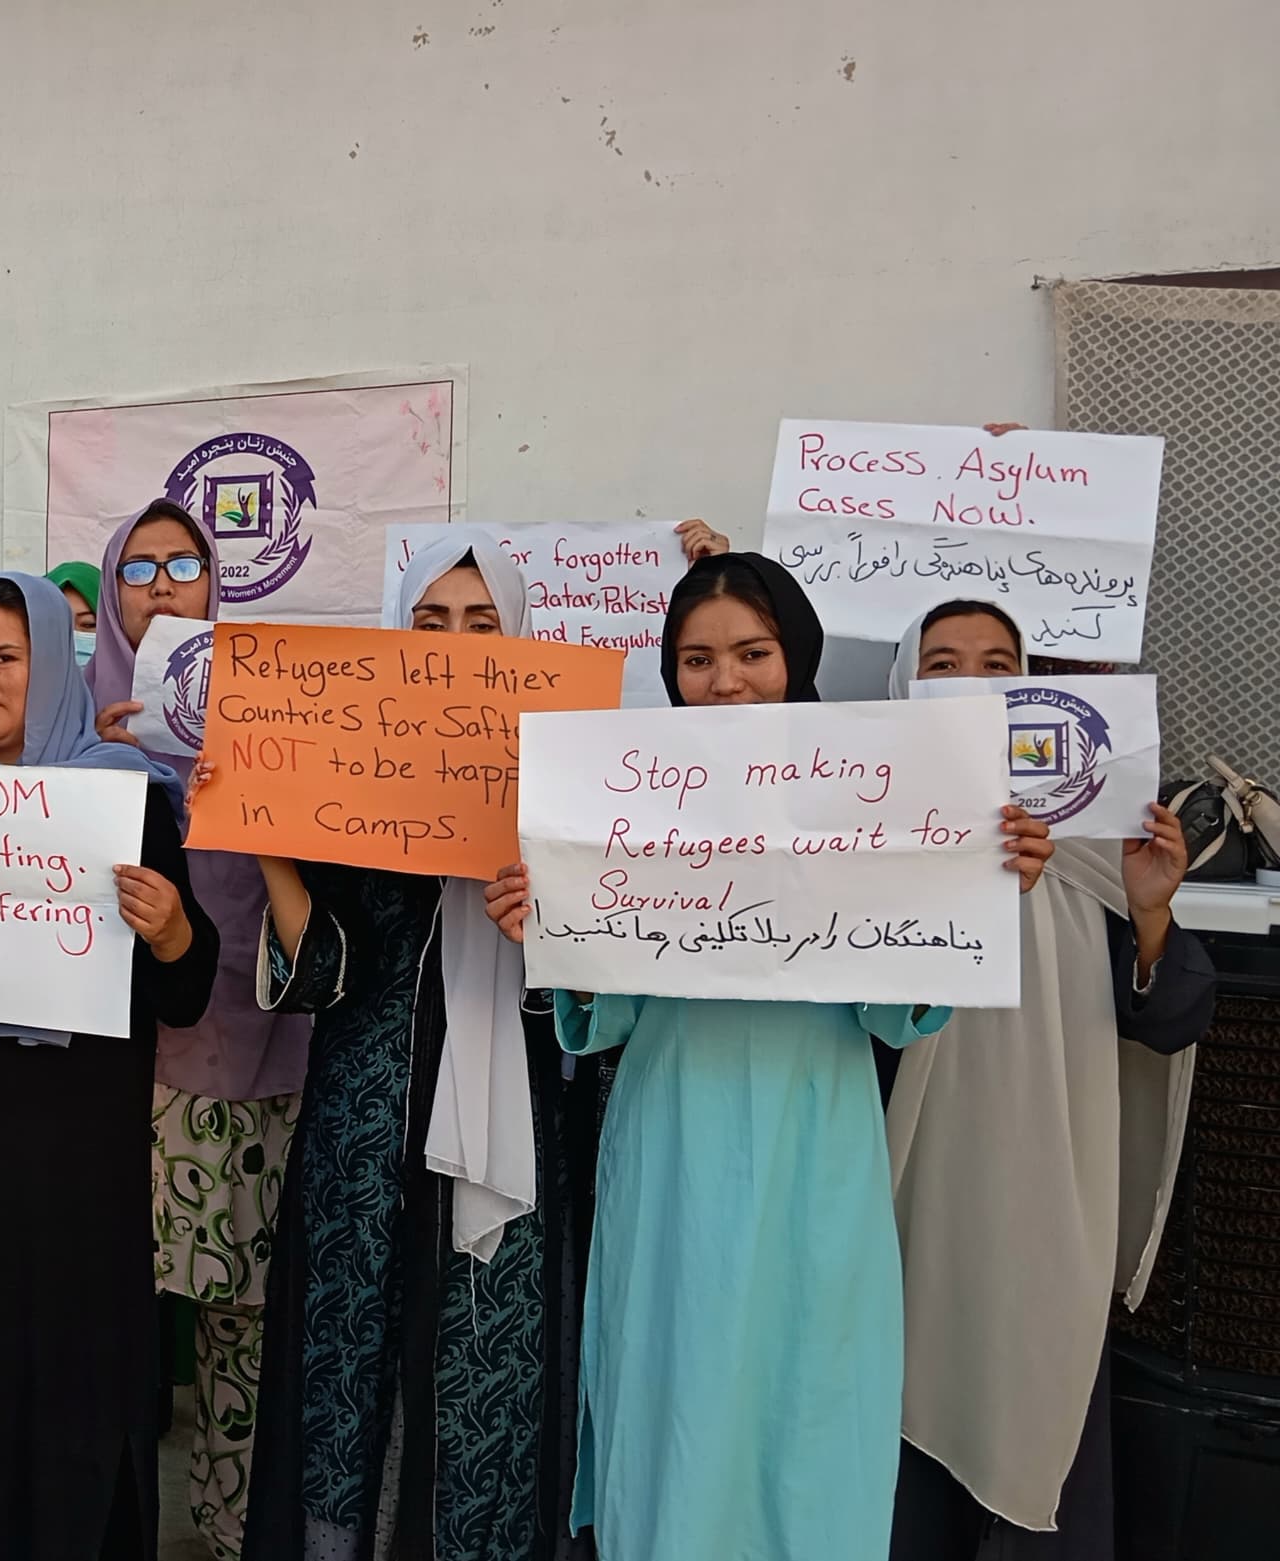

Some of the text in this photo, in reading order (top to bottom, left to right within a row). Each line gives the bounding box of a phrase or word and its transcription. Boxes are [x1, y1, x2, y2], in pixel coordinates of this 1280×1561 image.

[176, 434, 298, 482] جنبش زنان پنجره امید
[956, 446, 1089, 501] Asylum
[798, 487, 897, 520] Cases
[220, 566, 250, 578] 2022
[262, 555, 298, 590] Movement
[498, 538, 660, 583] or forgotten
[600, 585, 669, 615] Pakist
[581, 626, 662, 659] Everywhe
[229, 633, 560, 697] Refugees left thier
[218, 694, 363, 733] Countries
[378, 697, 427, 737] for
[1007, 692, 1029, 706] پنج
[232, 736, 316, 773] NOT
[434, 748, 519, 808] trapp
[604, 747, 893, 810] Stop making
[242, 794, 470, 855] in Camps.
[1019, 798, 1047, 808] 2022
[604, 808, 972, 870] Refugees wait for
[591, 868, 734, 912] Survival
[847, 918, 984, 966] پناهندگان
